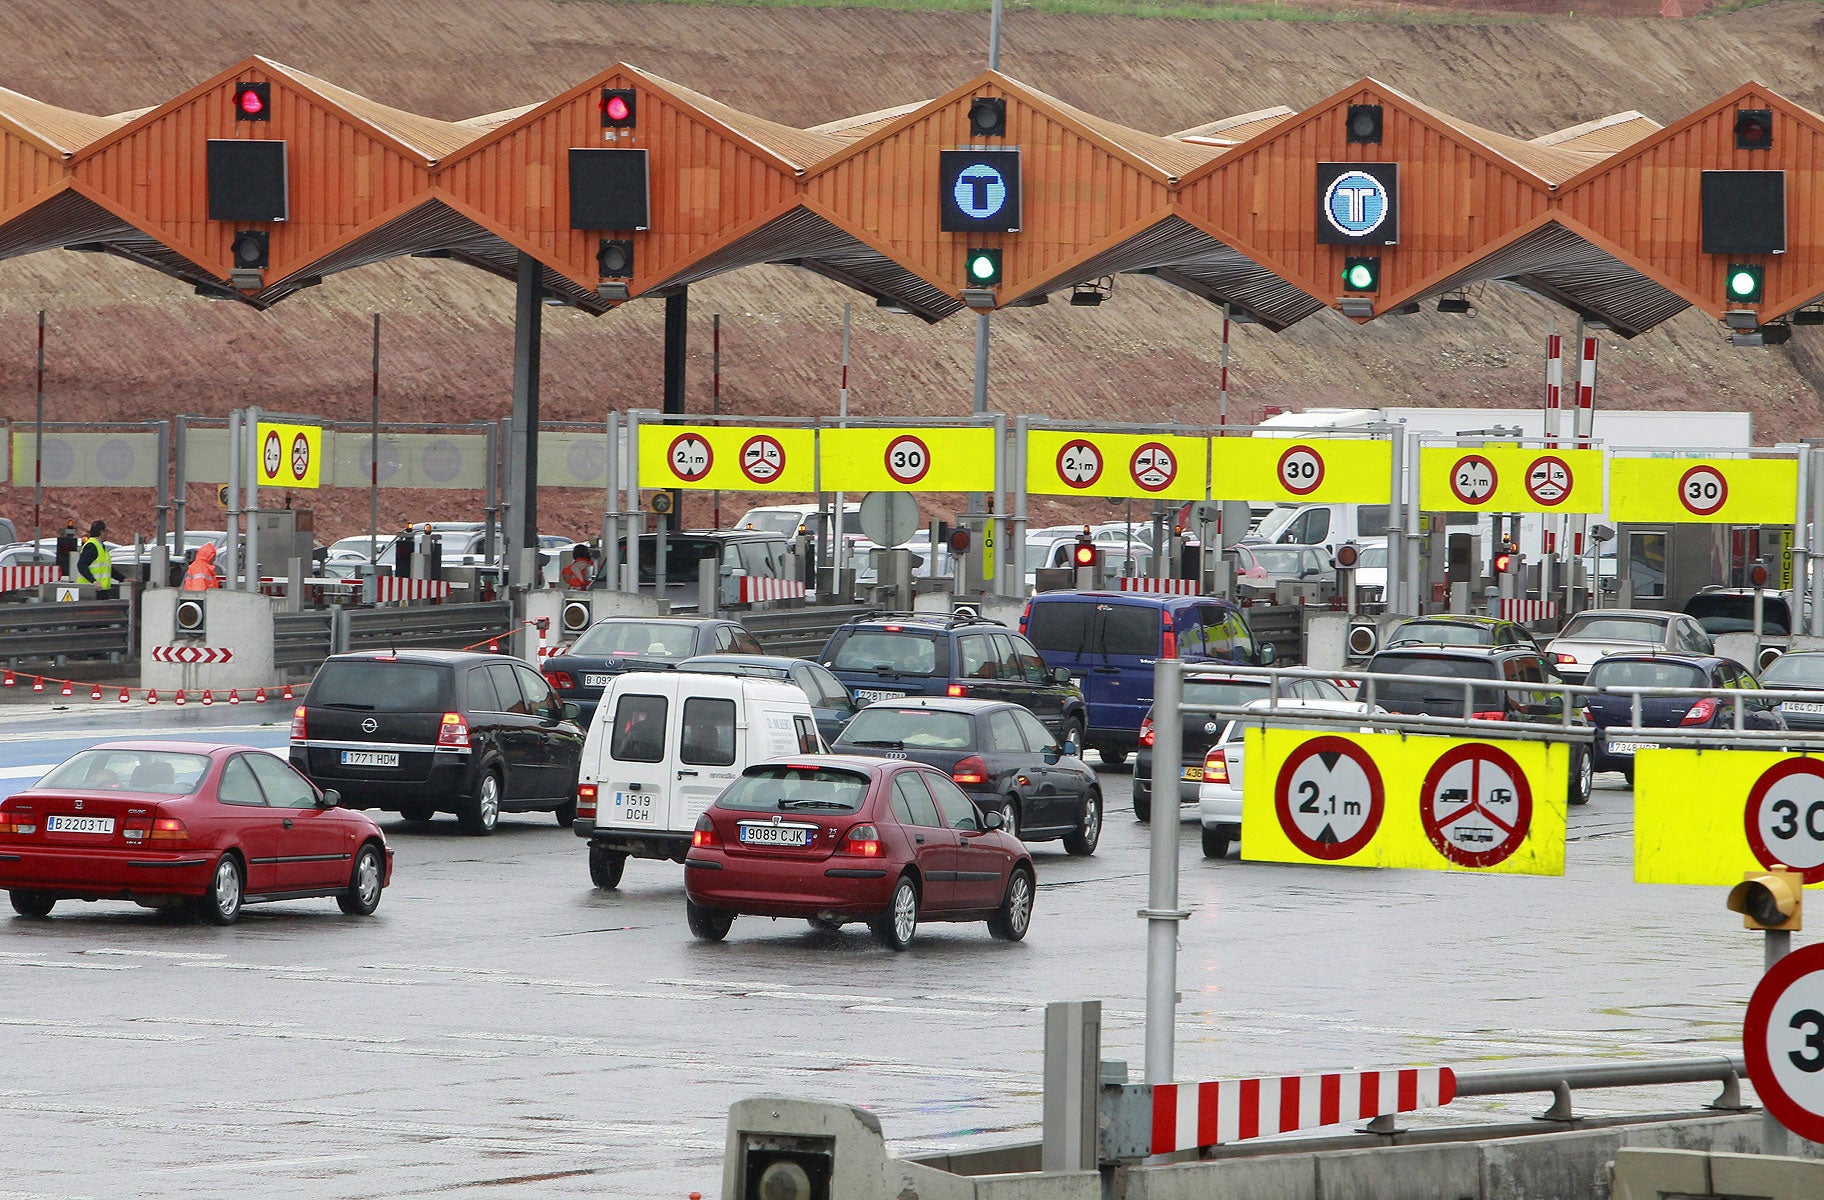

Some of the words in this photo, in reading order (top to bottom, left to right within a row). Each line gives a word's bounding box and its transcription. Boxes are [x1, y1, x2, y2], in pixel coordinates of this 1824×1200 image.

[894, 451, 921, 468] 30
[1287, 461, 1314, 478] 30
[1689, 482, 1717, 499] 30
[349, 753, 373, 763] 1771
[626, 794, 650, 806] 1519
[1298, 780, 1336, 816] 2,1
[1344, 801, 1361, 815] m
[626, 808, 648, 820] DCH
[748, 828, 777, 840] 9089
[781, 830, 803, 842] CJK
